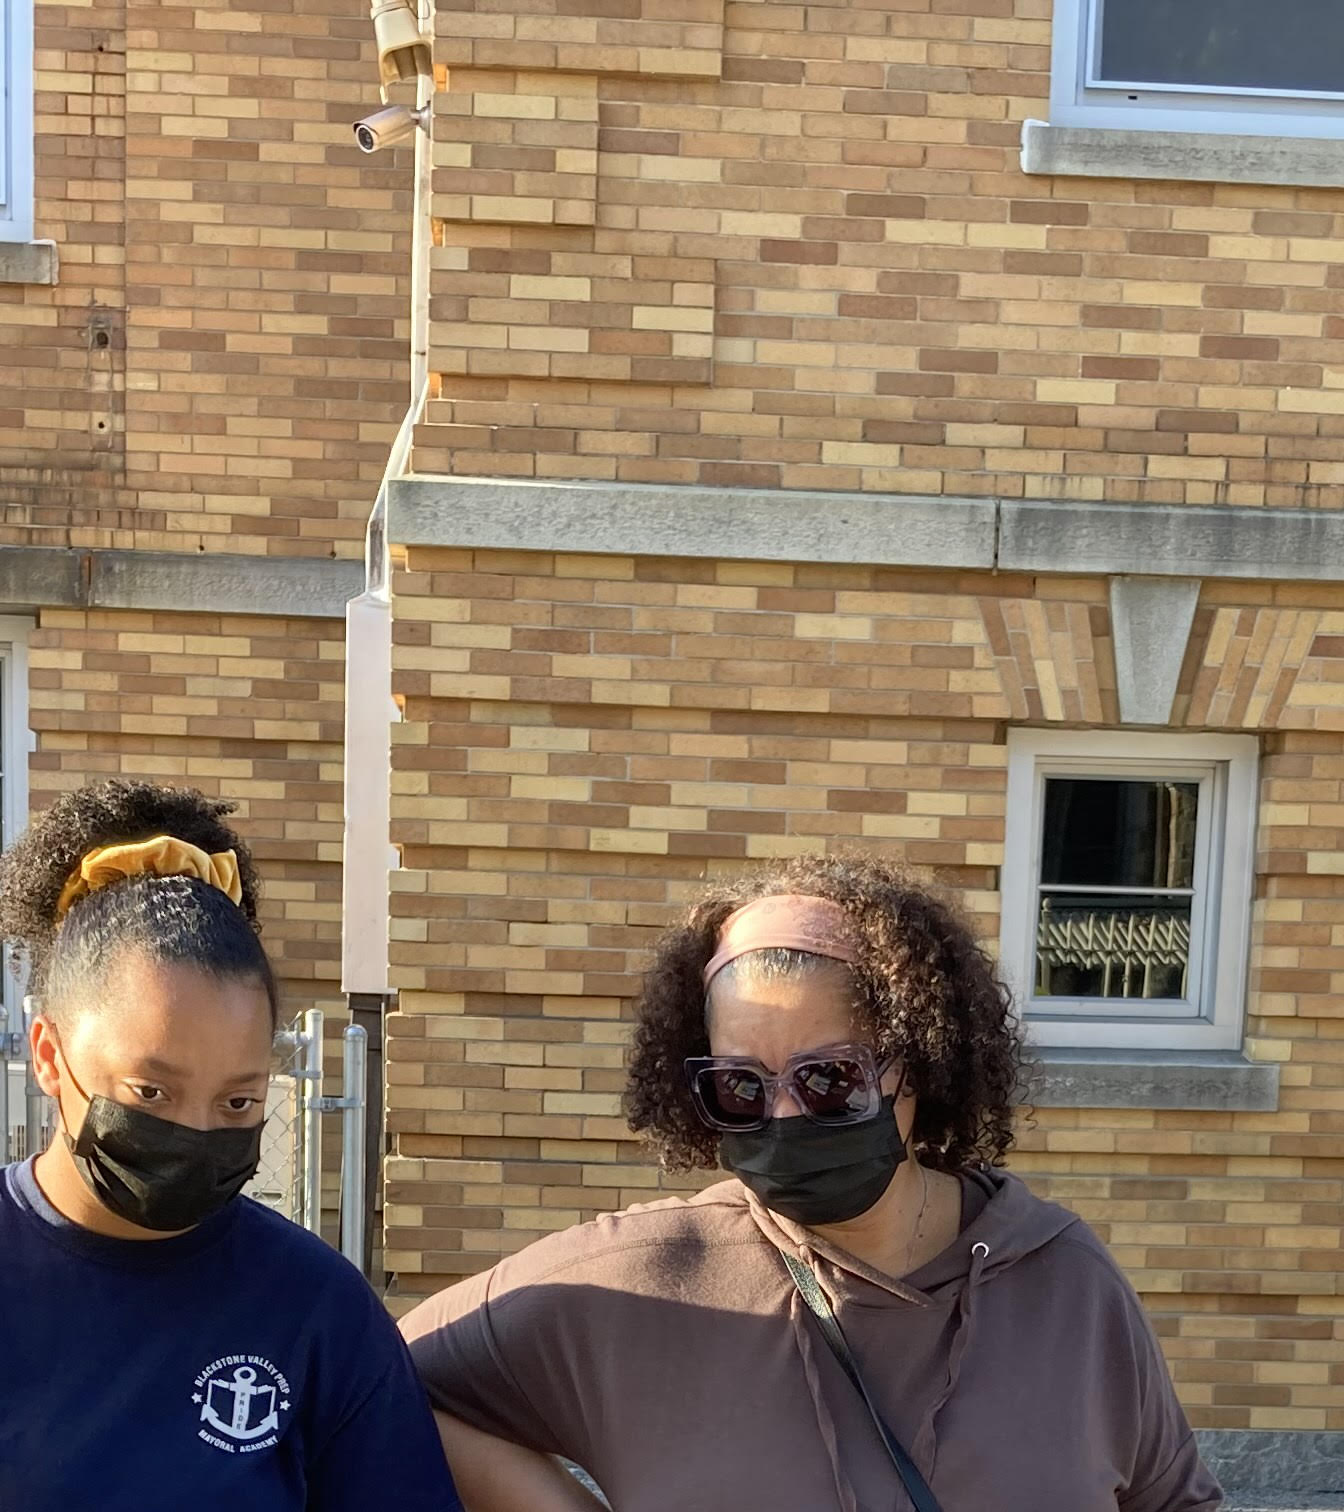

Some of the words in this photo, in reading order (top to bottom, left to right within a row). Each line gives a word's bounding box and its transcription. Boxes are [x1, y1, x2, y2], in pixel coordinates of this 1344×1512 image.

[194, 1355, 246, 1387] BLACKSTONE
[248, 1355, 278, 1375] VALLEY
[274, 1373, 290, 1394] PREP
[198, 1429, 235, 1453] MAYORAL
[240, 1435, 278, 1452] ACADEMY
